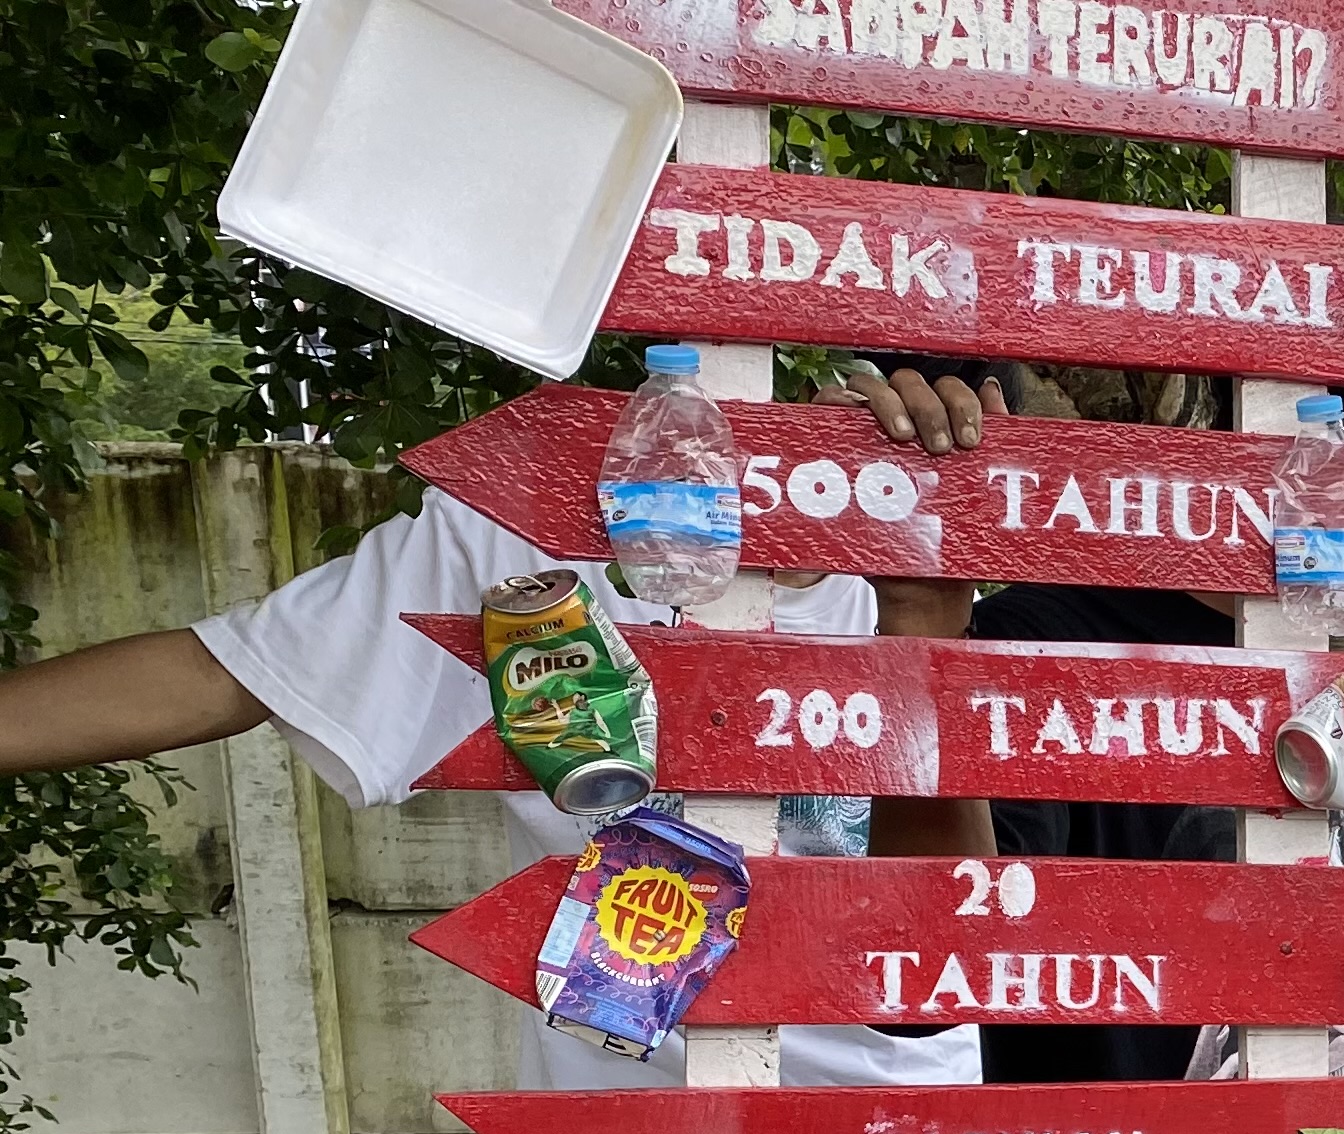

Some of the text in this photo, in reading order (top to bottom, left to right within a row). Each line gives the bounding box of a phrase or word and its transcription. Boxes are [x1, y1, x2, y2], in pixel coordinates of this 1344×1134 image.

[650, 208, 1336, 328] TIDAK TEURAI
[743, 456, 1276, 548] 500 TAHUN
[506, 618, 565, 640] CALCIUM
[515, 653, 589, 685] MILO
[754, 688, 1267, 760] 200 TAHUN
[613, 879, 698, 928] FRUIT
[952, 859, 1037, 918] 20
[611, 902, 686, 957] TEA
[865, 950, 1165, 1015] TAHUN
